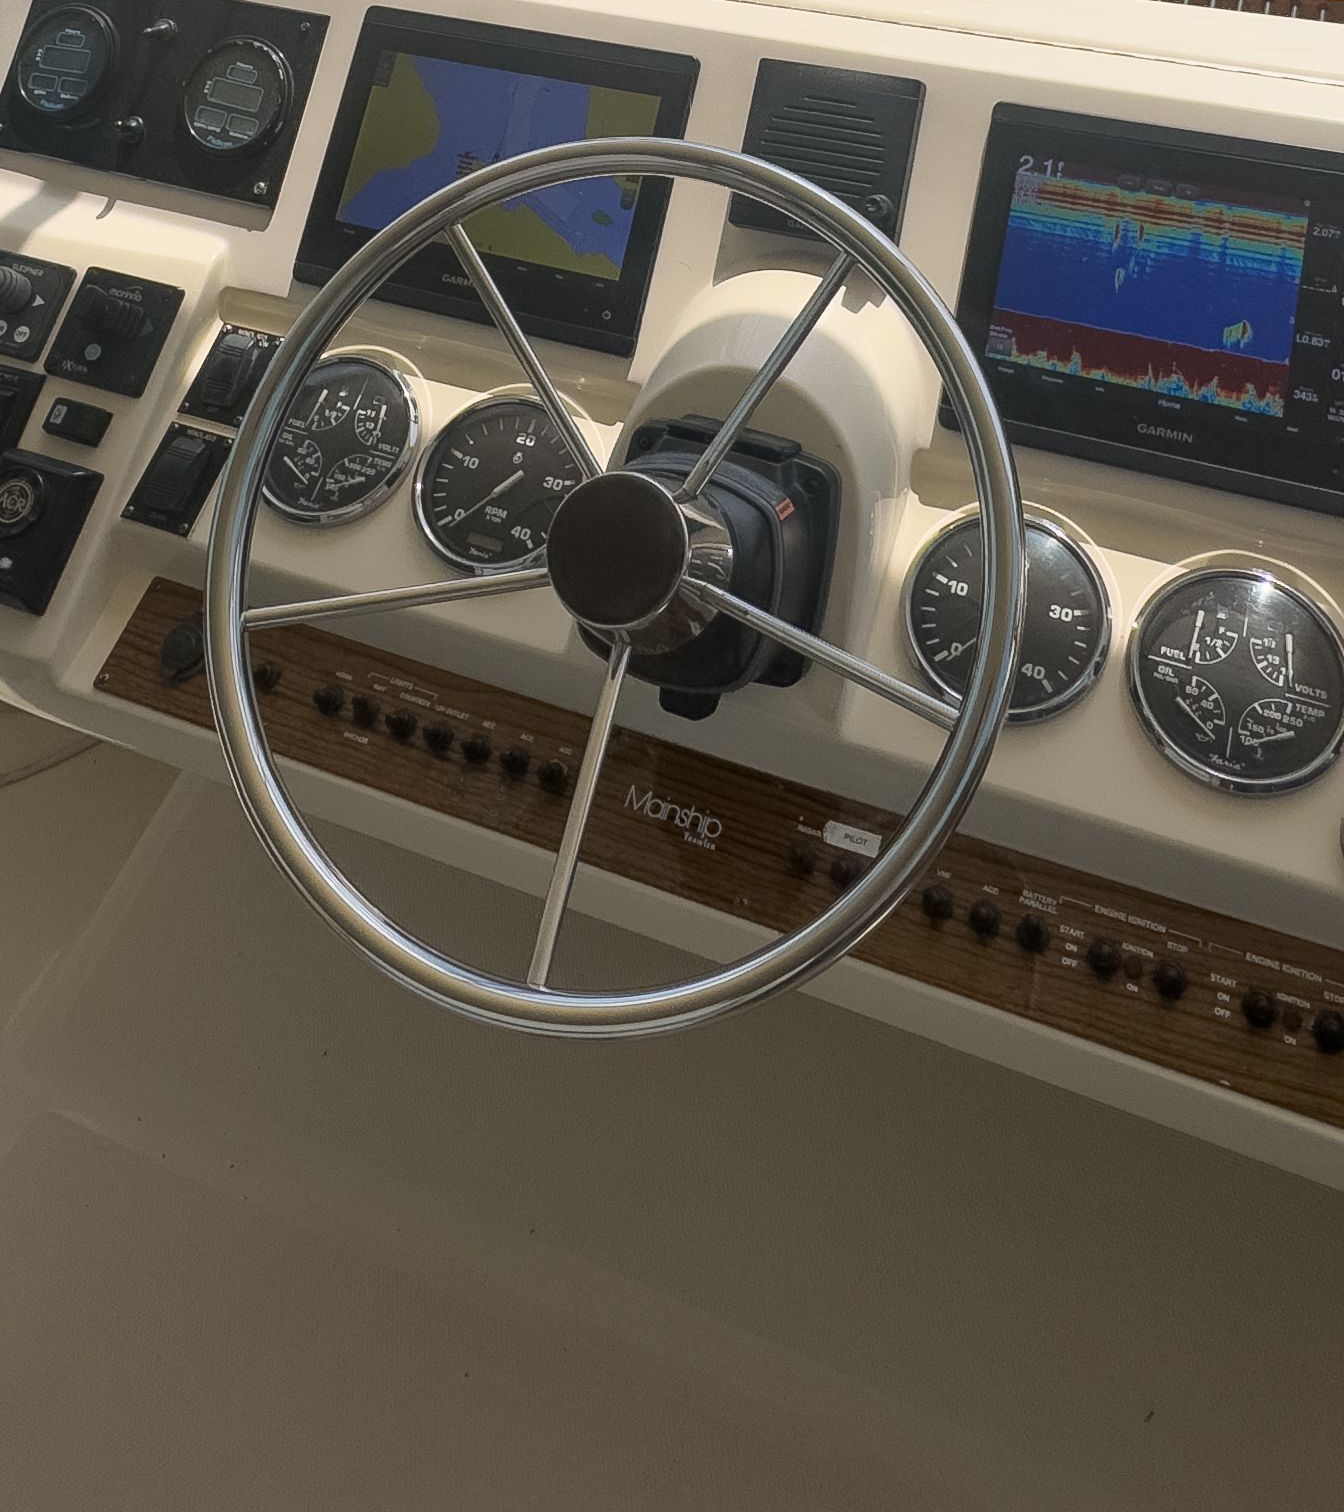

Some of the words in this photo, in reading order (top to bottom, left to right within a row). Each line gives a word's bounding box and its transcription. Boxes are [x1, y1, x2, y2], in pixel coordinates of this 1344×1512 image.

[1018, 154, 1052, 177] 2.1
[516, 433, 536, 447] 20
[1136, 423, 1193, 443] GARMIN
[462, 457, 479, 470] 10
[543, 476, 564, 491] 30
[485, 506, 508, 519] RPM
[510, 525, 532, 540] 40
[947, 580, 969, 597] 10
[1048, 604, 1074, 623] 30
[1205, 637, 1224, 649] 1/2
[1160, 645, 1186, 661] FUEL
[1266, 654, 1280, 665] 13
[1021, 663, 1046, 680] 40
[1157, 664, 1175, 677] OIL
[1294, 682, 1328, 699] VOLTS
[1263, 708, 1282, 720] 200
[1296, 703, 1326, 717] TEMP
[1282, 714, 1304, 728] 250
[624, 784, 723, 839] Mainship
[1022, 889, 1058, 906] BATTERY
[1094, 904, 1128, 922] ENGINE
[1128, 915, 1167, 934] IGNITION
[1059, 924, 1085, 939] START
[1065, 942, 1078, 953] ON
[1061, 957, 1079, 968] OFF
[1245, 952, 1281, 971] ENGINE
[1281, 963, 1323, 984] IGNITION
[1126, 982, 1139, 993] ON
[1209, 973, 1237, 988] START
[1217, 991, 1231, 1003] ON
[1214, 1007, 1232, 1019] OFF
[1283, 1035, 1297, 1047] ON
